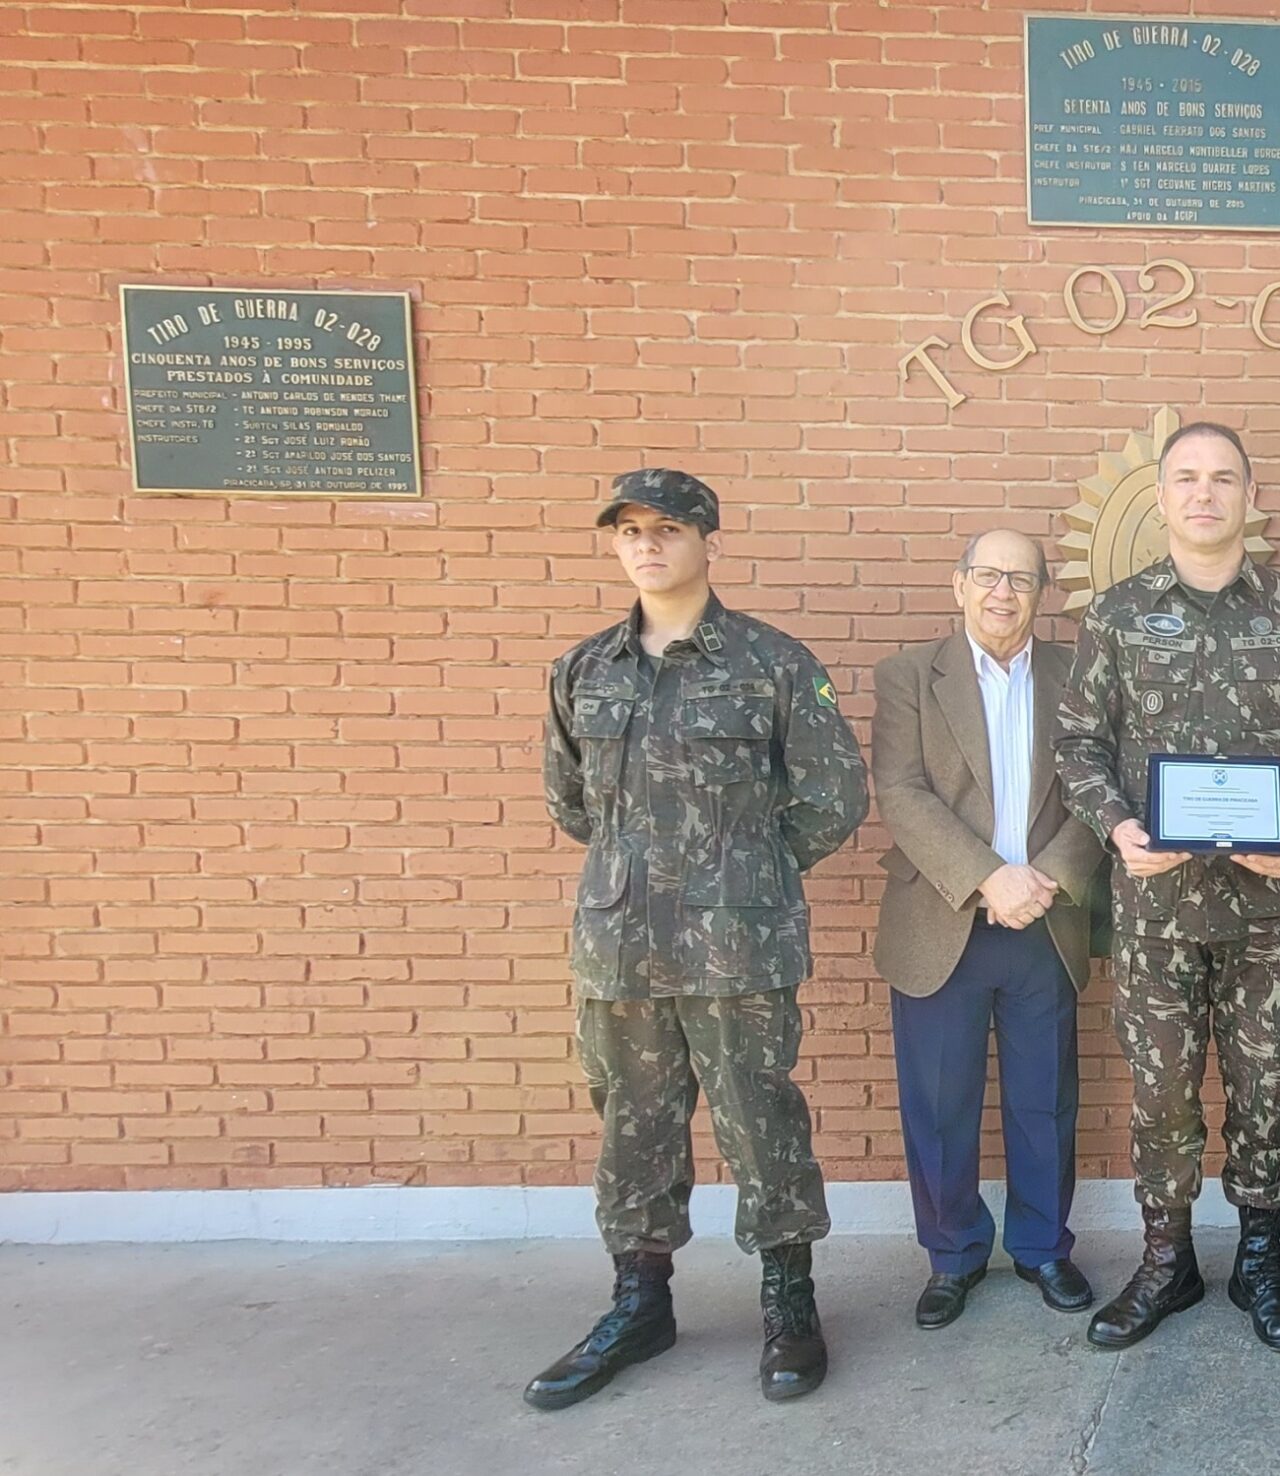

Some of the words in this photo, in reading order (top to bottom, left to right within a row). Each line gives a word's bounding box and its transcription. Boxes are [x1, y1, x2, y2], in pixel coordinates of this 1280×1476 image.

[1059, 39, 1095, 70] TIRO
[1102, 29, 1123, 51] DE
[1132, 25, 1188, 48] GUERRA
[1121, 77, 1153, 92] 1945
[1172, 78, 1202, 93] 2015
[1064, 98, 1112, 115] SETENTA
[1120, 100, 1147, 116] ANOS
[1156, 101, 1170, 117] DE
[1178, 102, 1206, 118] BONS
[1214, 103, 1263, 120] SERVIÇOS
[1060, 125, 1102, 135] MUNICIPAL
[1119, 124, 1157, 136] GABRIEL
[1163, 125, 1204, 137] FERRATO
[1209, 126, 1226, 138] DOS
[1231, 127, 1267, 138] SANTOS
[1033, 143, 1060, 153] CHEFE
[1066, 144, 1078, 153] DA
[1119, 144, 1138, 154] MAJ
[1143, 144, 1184, 156] MARCELO
[1189, 145, 1248, 158] MONTIBELLER
[1033, 160, 1060, 169] CHEFE
[1066, 161, 1112, 171] INSTRUTOR
[1133, 160, 1150, 171] TEN
[1156, 161, 1197, 173] MARCELO
[1202, 163, 1237, 174] DUARTE
[1242, 164, 1270, 176] LOPES
[1033, 178, 1080, 187] INSTRUTOR
[1134, 178, 1151, 189] SGT
[1157, 179, 1197, 191] GEOVANE
[1238, 181, 1276, 193] MARTINS
[1148, 198, 1160, 207] DE
[1165, 198, 1203, 208] OUTUBRO
[1209, 199, 1220, 208] DE
[1126, 212, 1151, 221] APOIO
[1157, 213, 1168, 221] DA
[146, 314, 189, 345] TIRO
[197, 303, 221, 326] DE
[234, 299, 298, 321] GUERRA
[314, 308, 382, 352] 02-028
[223, 336, 261, 350] 1945
[277, 337, 312, 351] 1995
[898, 292, 1038, 410] TG
[131, 353, 212, 366] CINQUENTA
[220, 355, 257, 367] ANOS
[264, 356, 283, 368] DE
[290, 357, 328, 369] BONS
[334, 358, 406, 371] SERVIÇOS
[166, 370, 253, 383] PRESTADOS
[281, 373, 374, 386] COMUNIDADE
[133, 389, 179, 398] PREFEITO
[182, 391, 228, 400] MUNICIPAL
[241, 391, 279, 400] ANTONIO
[283, 392, 319, 401] CARLOS
[323, 392, 336, 401] DE
[340, 393, 375, 403] MENDES
[135, 404, 165, 413] CHEFE
[169, 405, 181, 413] DA
[242, 405, 255, 415] TC
[260, 406, 299, 416] ANTONIO
[303, 407, 349, 417] ROBINSON
[136, 419, 166, 428] CHEFE
[282, 421, 311, 431] SILAS
[316, 422, 364, 432] ROMUALDO
[137, 434, 199, 443] INSTRUTORES
[313, 436, 335, 446] LUIZ
[356, 452, 375, 461] DOS
[377, 453, 412, 463] SANTOS
[314, 466, 353, 476] ANTONIO
[357, 467, 396, 477] PELIZER
[310, 481, 321, 489] DE
[326, 481, 366, 490] OUTUBRO
[370, 482, 382, 490] DE
[1142, 635, 1183, 648] PERSON
